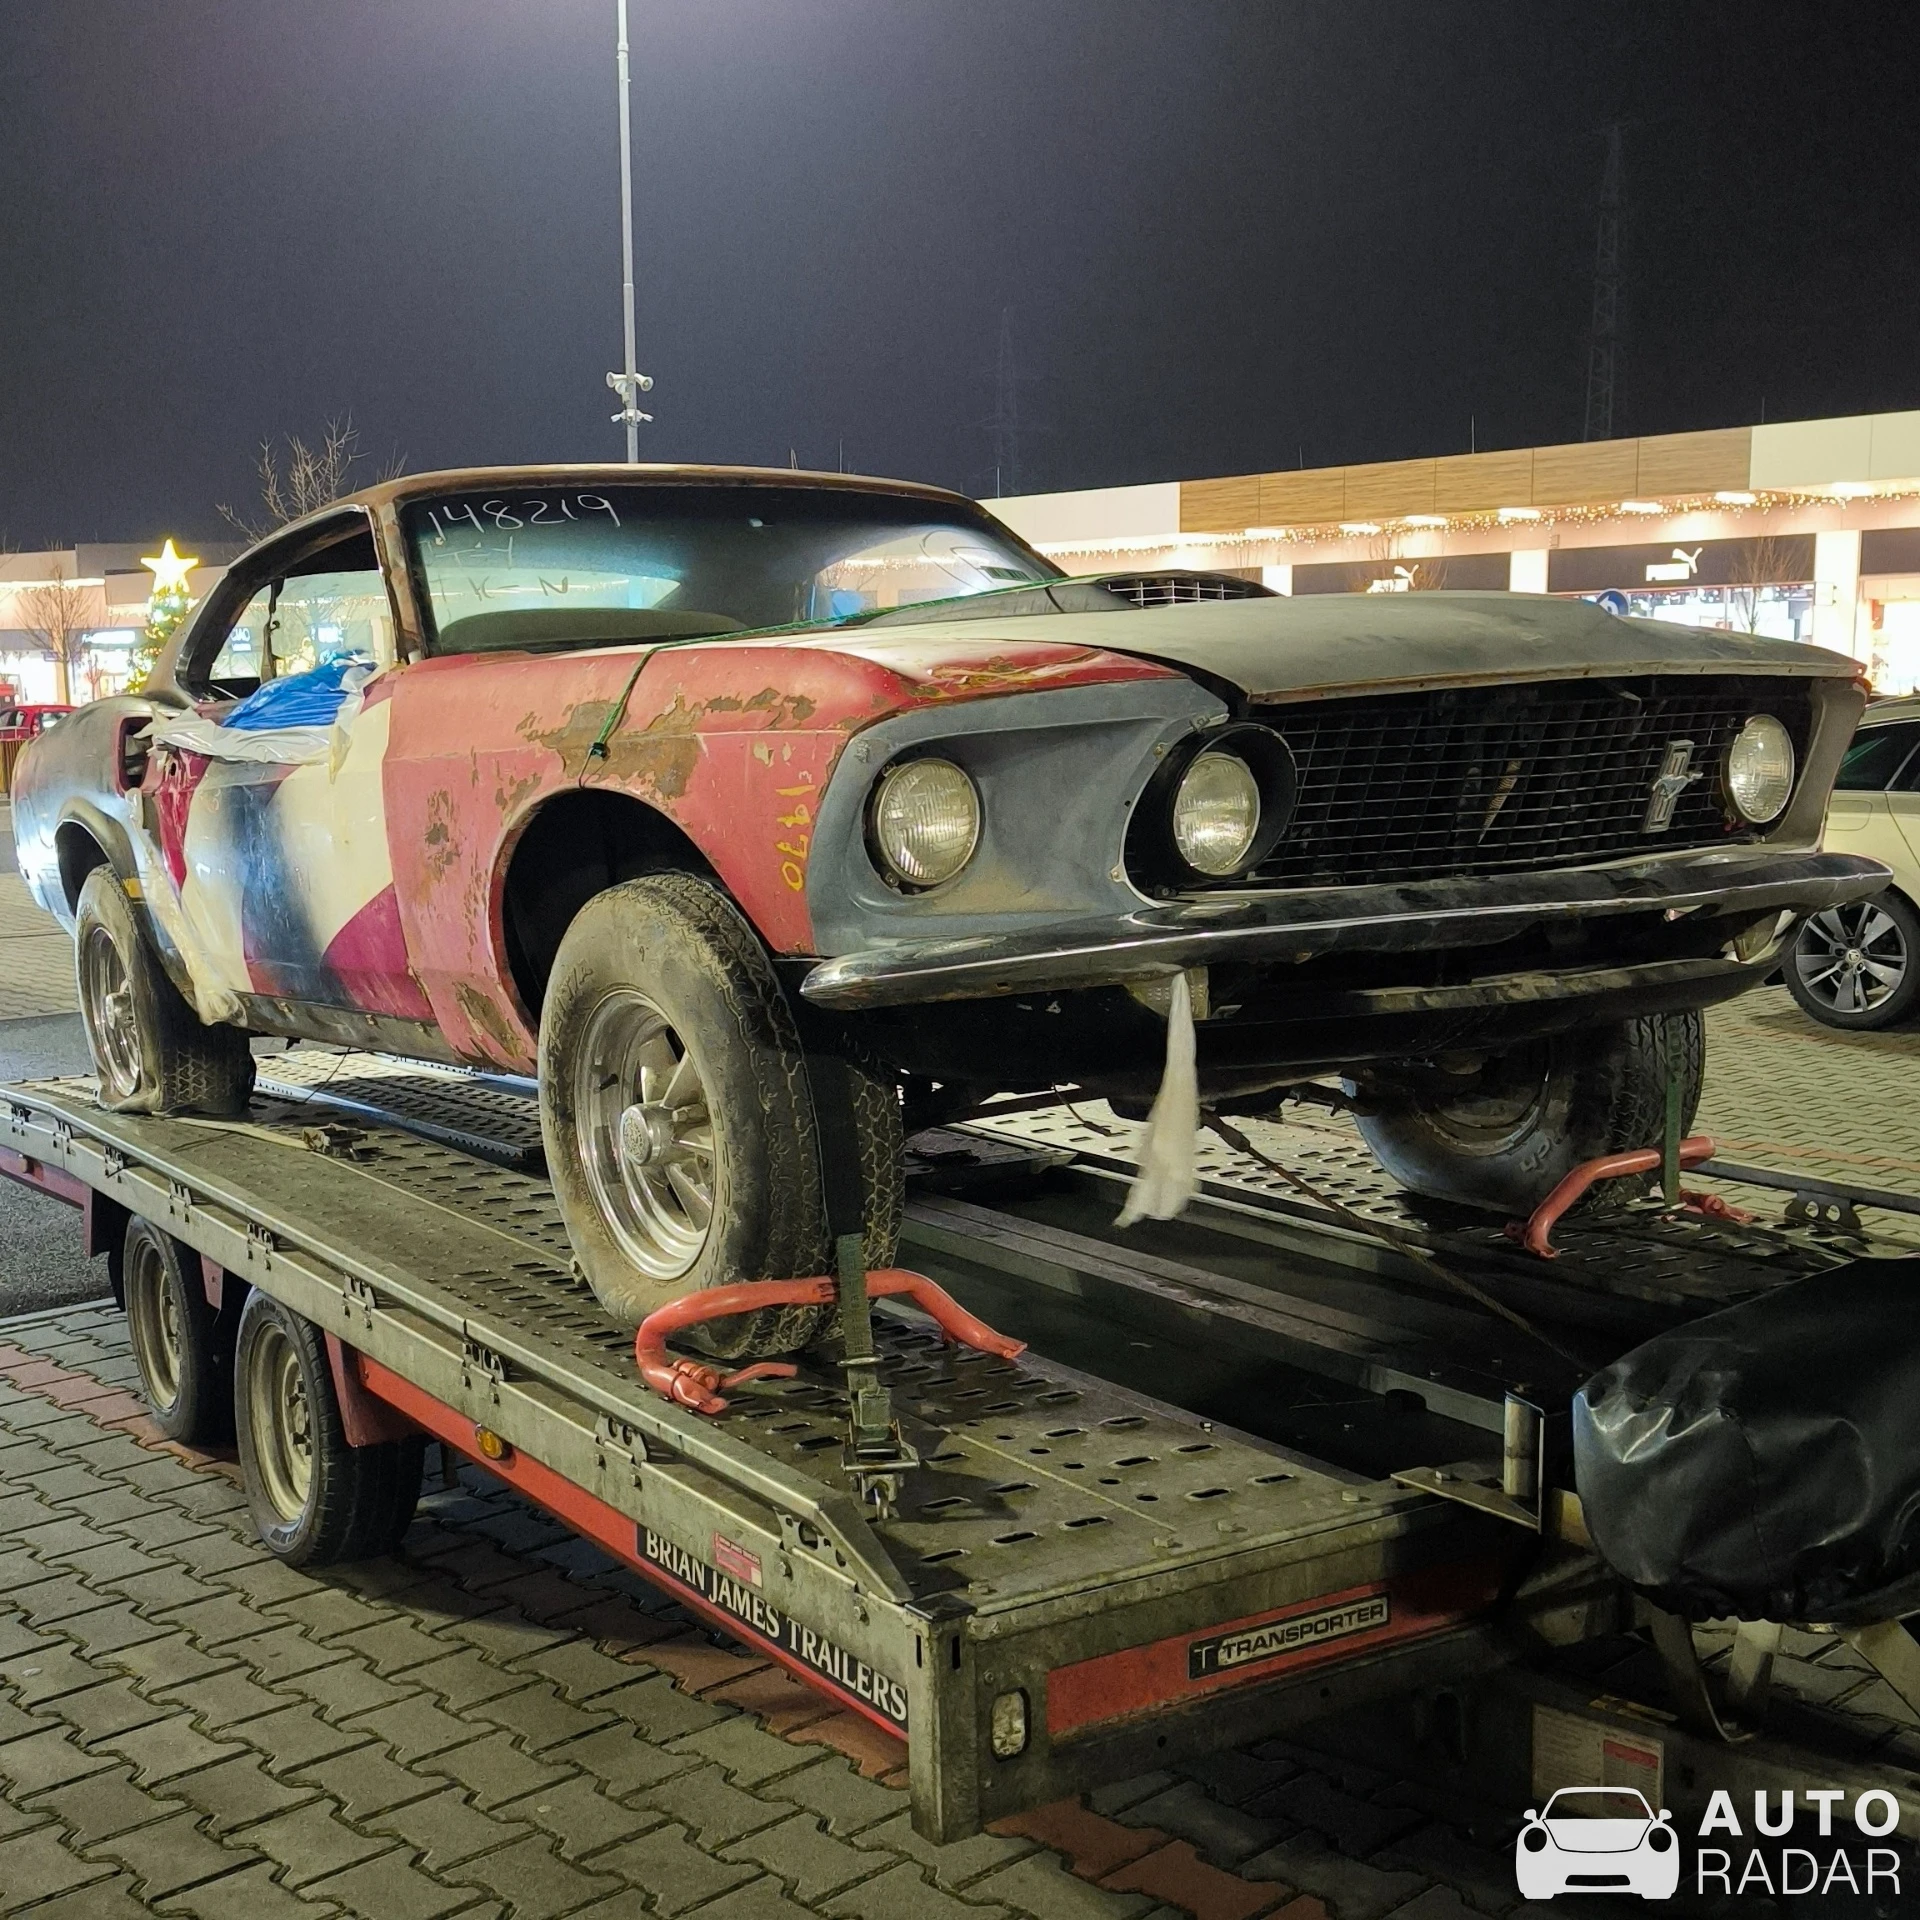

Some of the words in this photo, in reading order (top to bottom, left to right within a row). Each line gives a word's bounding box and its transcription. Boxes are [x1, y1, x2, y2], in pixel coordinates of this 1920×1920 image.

[428, 494, 621, 541] 148219
[646, 1529, 705, 1591] BRIAN
[709, 1570, 780, 1638] JAMES
[786, 1616, 907, 1721] TRAILERS
[1223, 1603, 1385, 1660] TRANSPORTER
